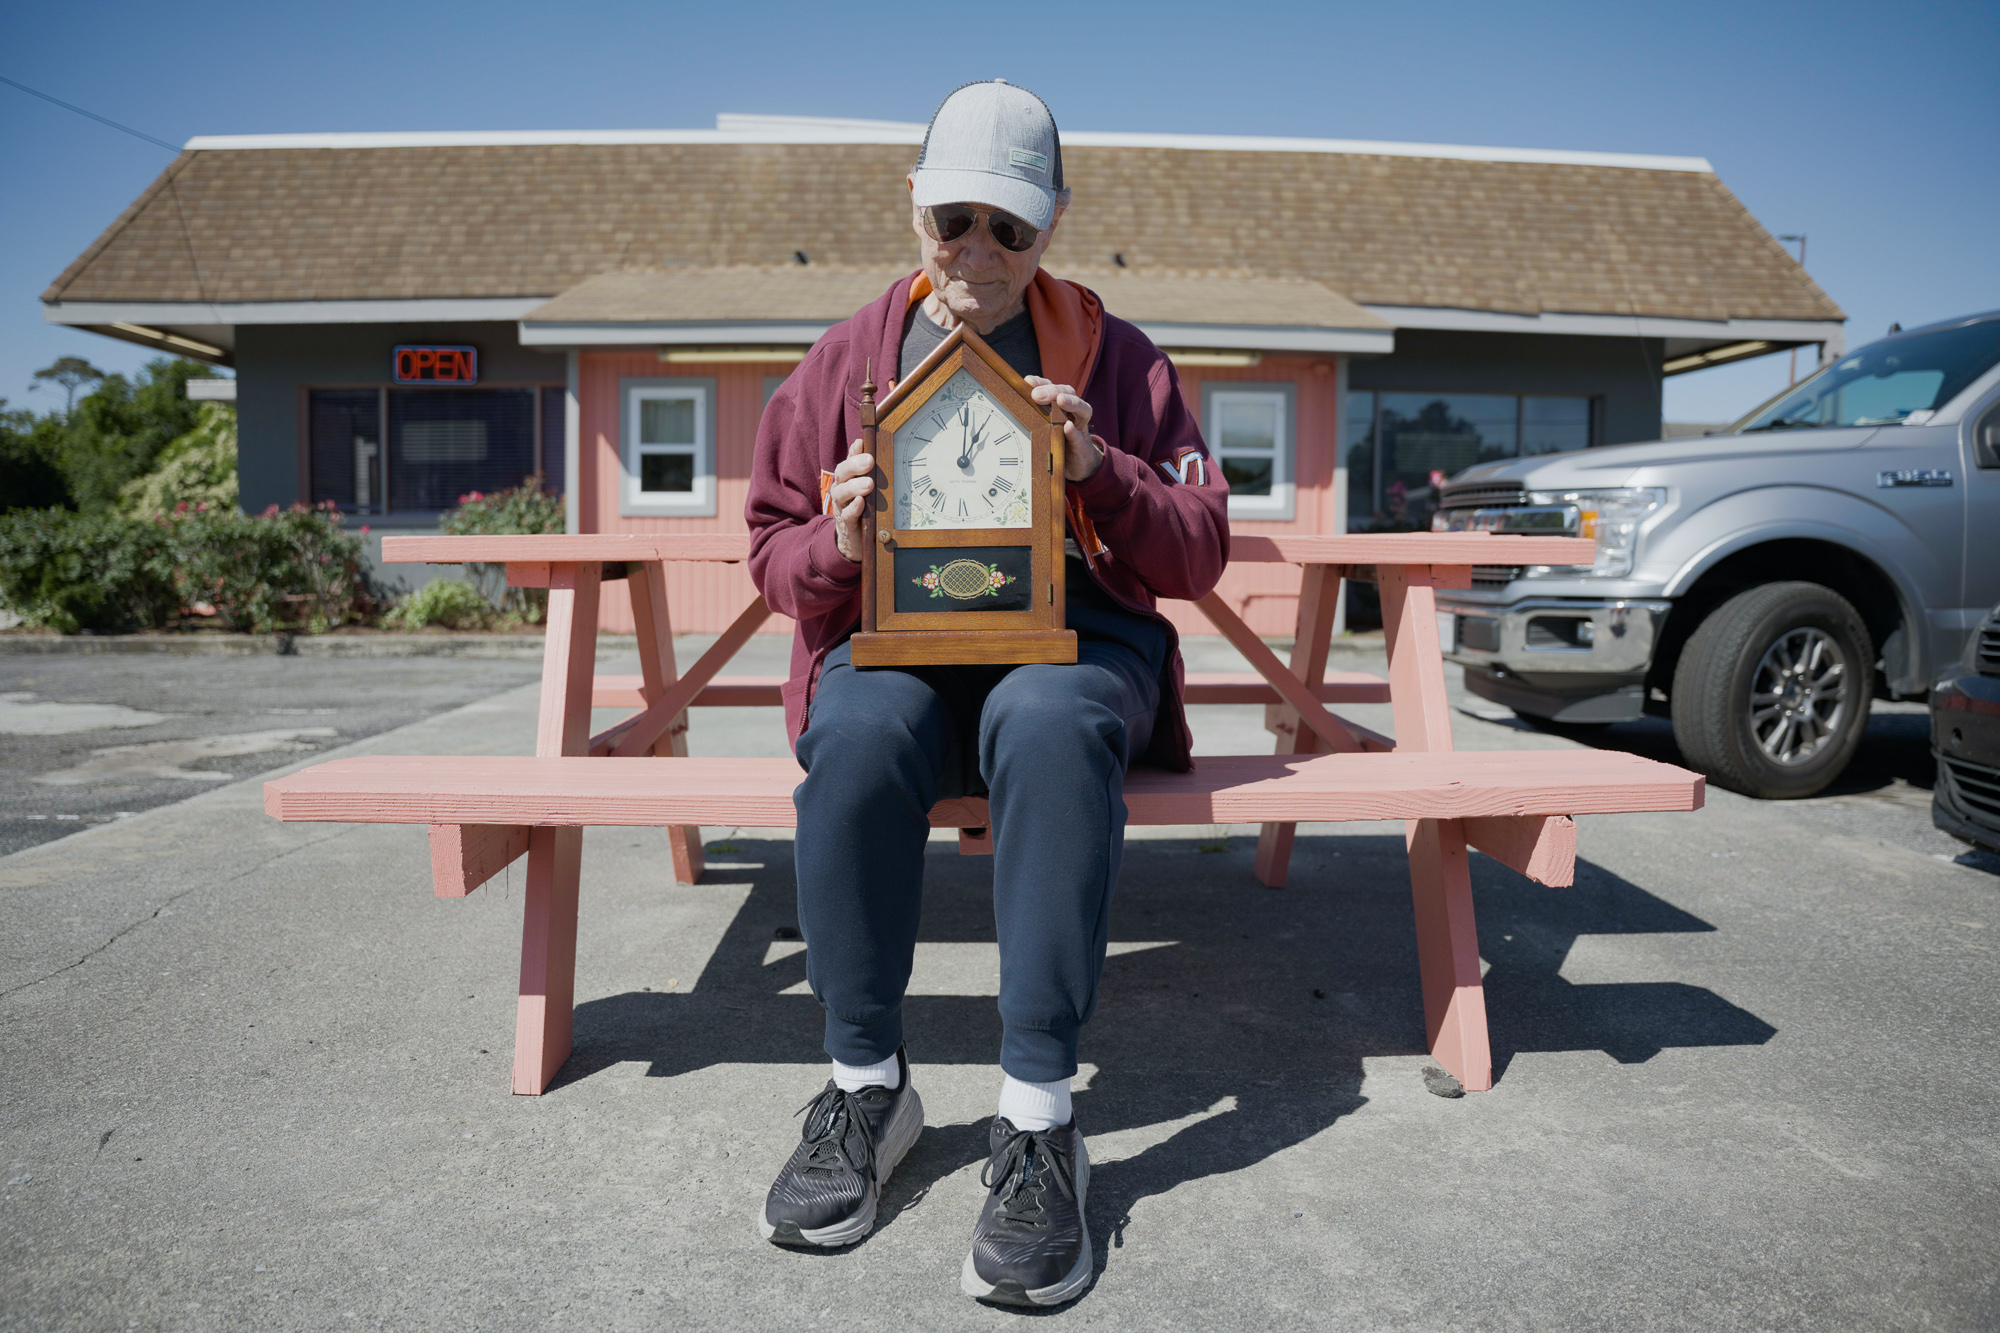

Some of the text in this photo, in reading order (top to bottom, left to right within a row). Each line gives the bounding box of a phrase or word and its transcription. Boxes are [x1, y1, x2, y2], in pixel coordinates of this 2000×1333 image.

[396, 348, 474, 382] OPEN
[993, 432, 1012, 446] II
[999, 457, 1019, 466] III
